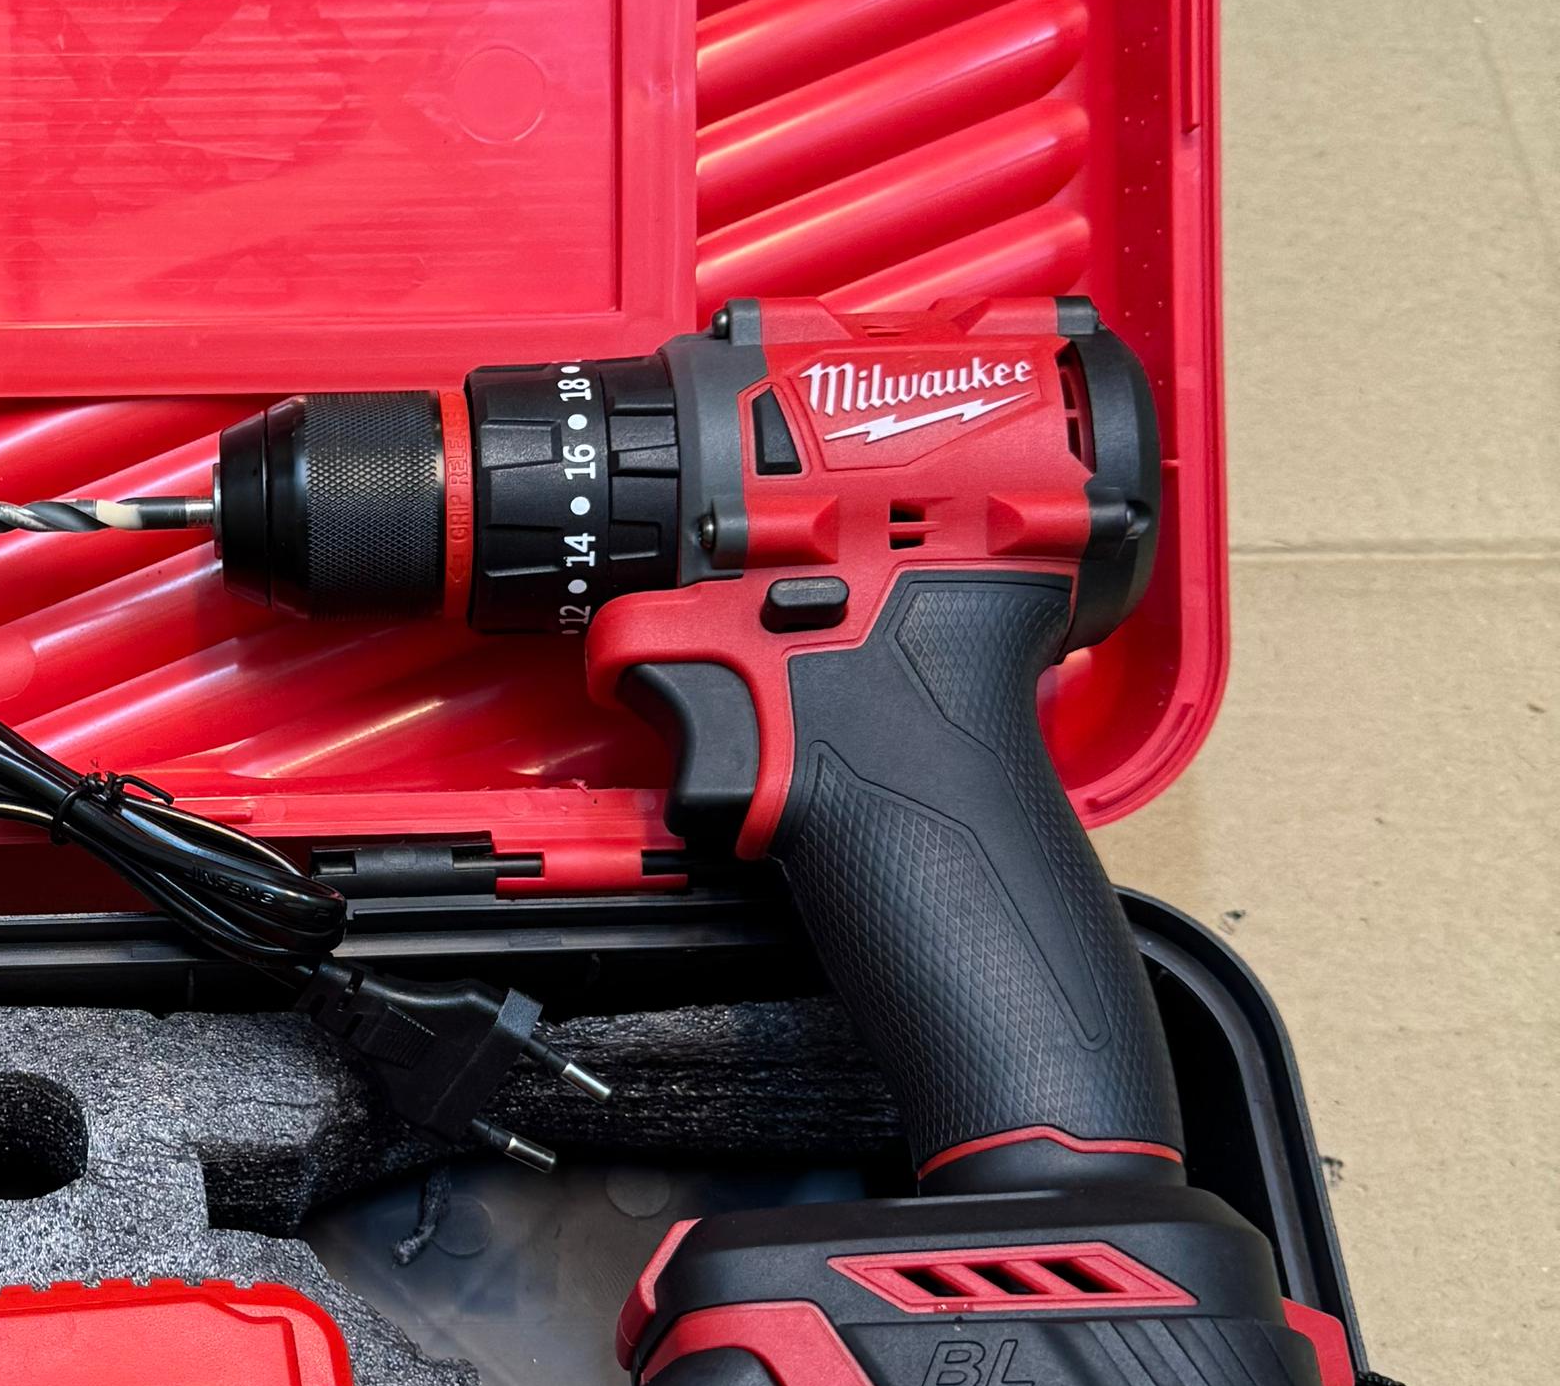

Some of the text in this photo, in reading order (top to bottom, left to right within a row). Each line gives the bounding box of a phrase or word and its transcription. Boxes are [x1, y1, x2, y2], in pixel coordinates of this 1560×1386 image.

[798, 356, 1032, 416] Milwaukee
[448, 493, 471, 544] GRIP
[557, 377, 597, 626] 12 14 16 18
